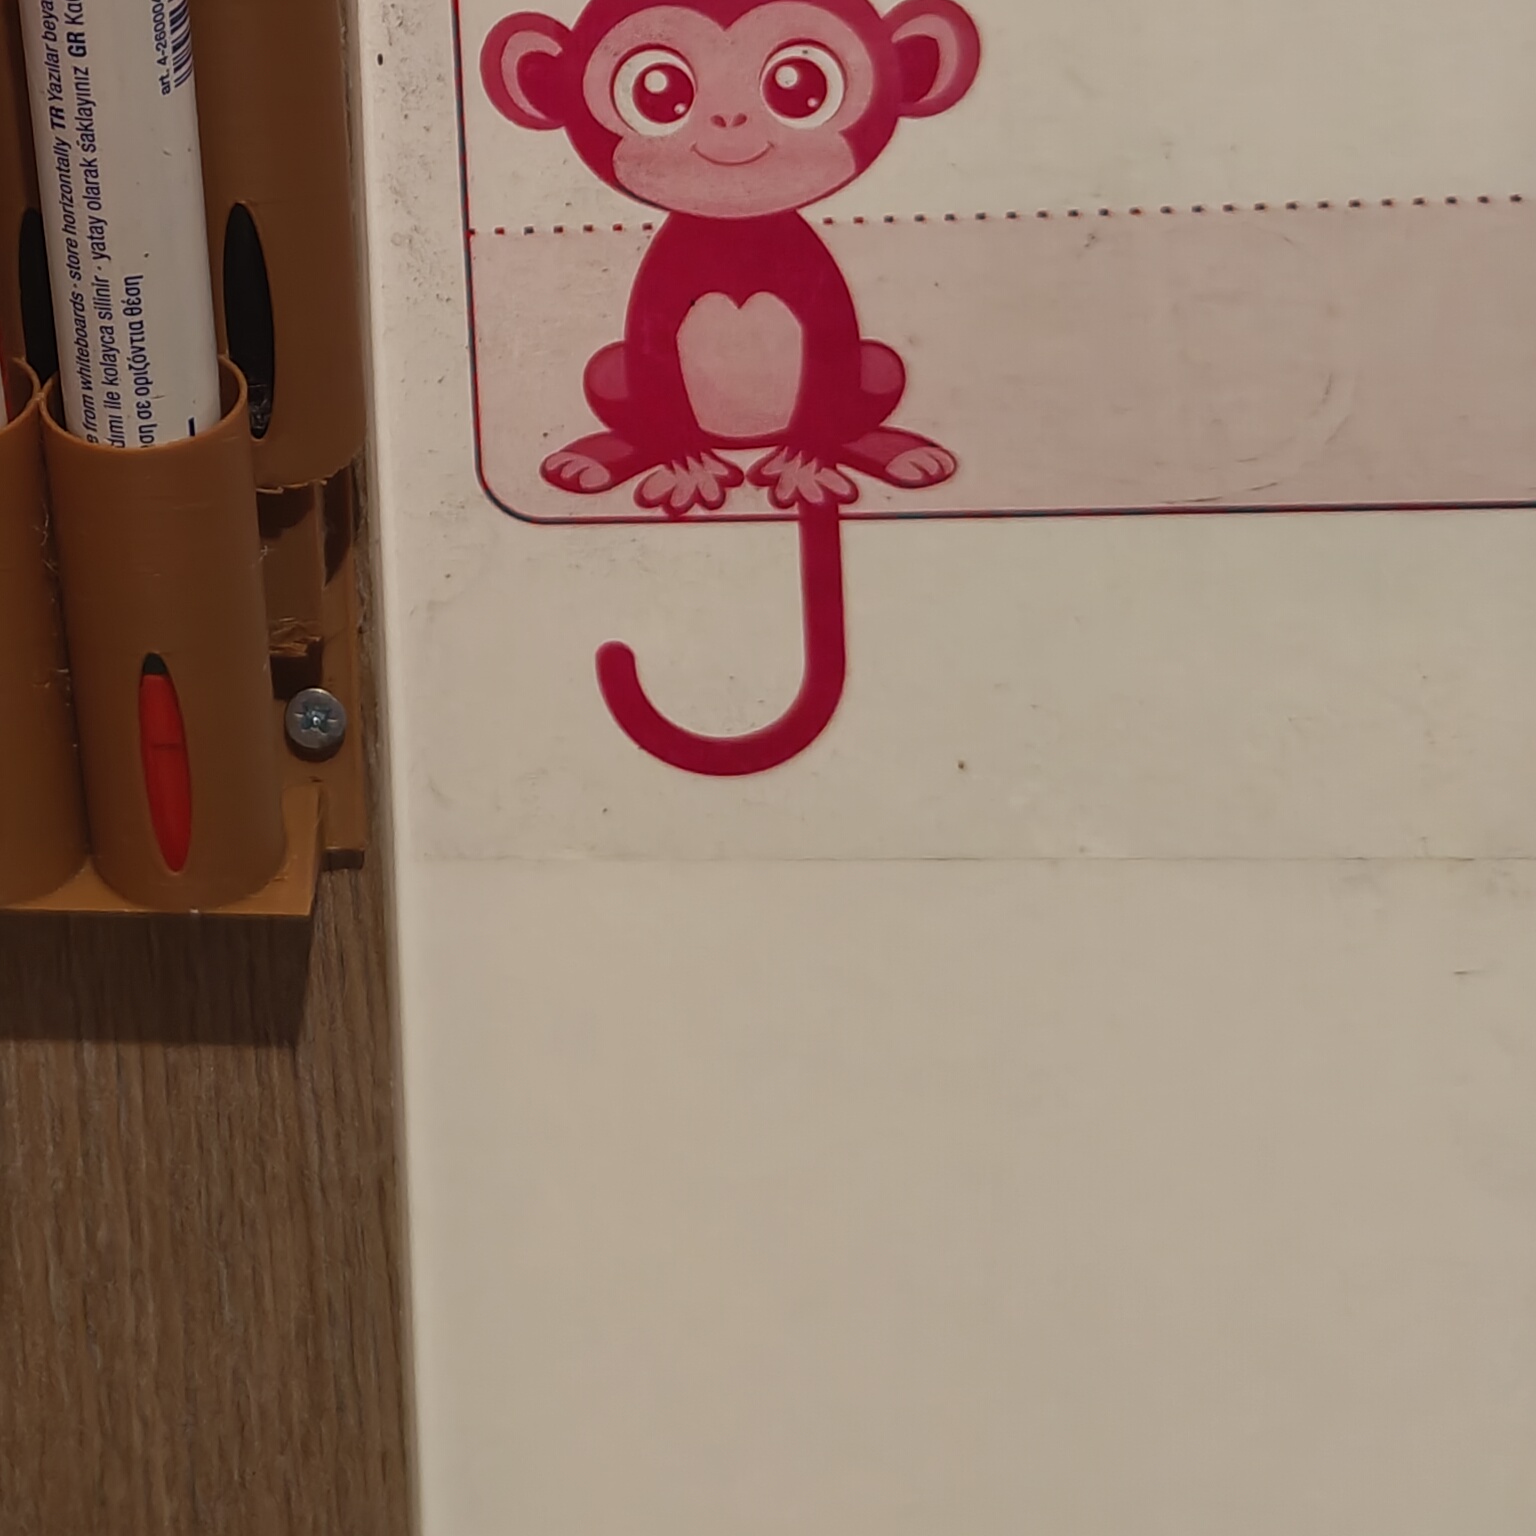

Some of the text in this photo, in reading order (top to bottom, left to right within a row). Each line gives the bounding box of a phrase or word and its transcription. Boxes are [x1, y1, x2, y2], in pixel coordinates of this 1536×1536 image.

[66, 30, 86, 57] GR
[42, 45, 63, 103] Yazılar
[157, 68, 172, 95] art.
[48, 103, 65, 131] TR
[68, 64, 101, 154] saklayınız
[51, 136, 76, 235] horizontally
[80, 157, 102, 212] olarak
[64, 238, 81, 281] store
[85, 213, 110, 262] yatay
[91, 272, 113, 321] silinir
[67, 289, 94, 391] whiteboards
[95, 324, 122, 387] kolayca
[80, 393, 97, 431] from
[103, 390, 121, 411] ile
